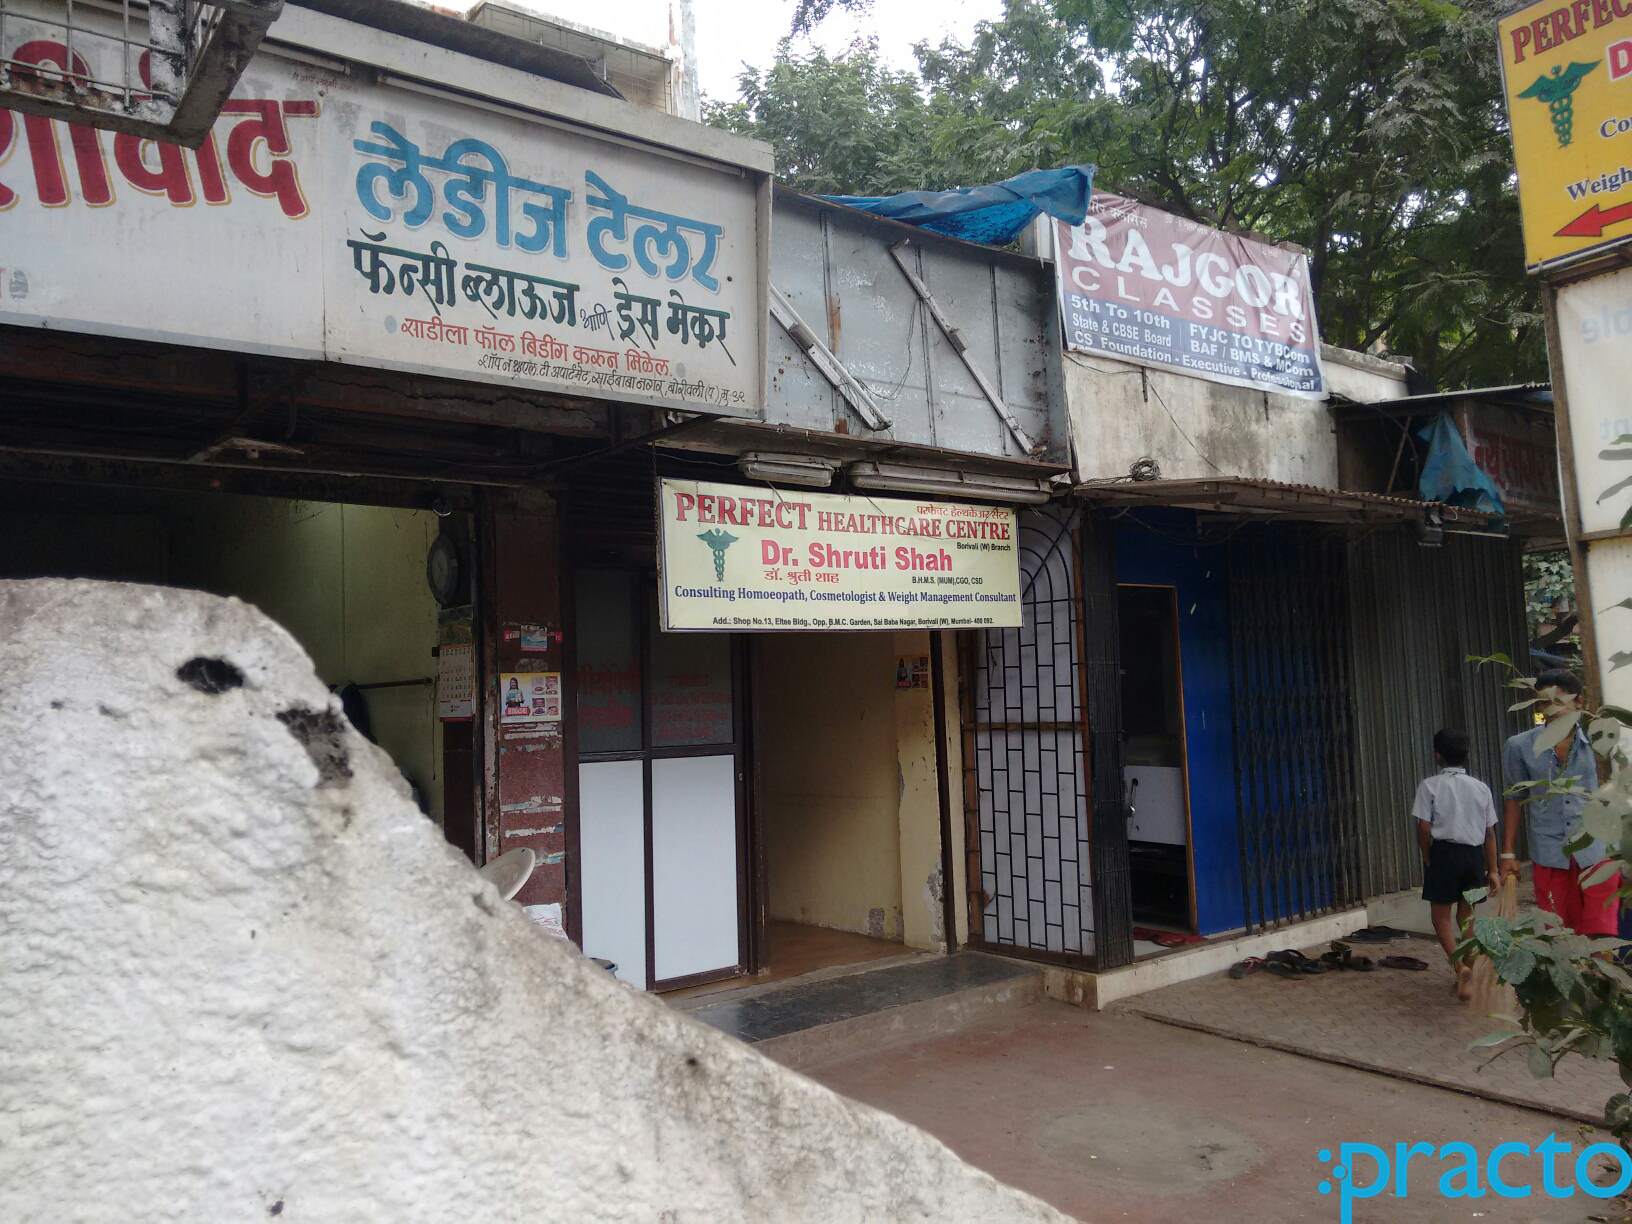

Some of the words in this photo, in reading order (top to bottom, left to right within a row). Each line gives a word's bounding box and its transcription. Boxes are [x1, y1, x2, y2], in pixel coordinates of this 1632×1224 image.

[1600, 117, 1632, 138] Co
[353, 121, 572, 260] लेडीज
[585, 169, 723, 293] टेलर
[1068, 216, 1305, 320] RAJGOR
[464, 262, 579, 328] ब्लाऊज
[666, 289, 736, 366] मेकर
[1071, 266, 1306, 343] CLASSES
[1071, 294, 1100, 313] 5th
[1105, 303, 1128, 319] To
[1134, 309, 1170, 329] 10th
[401, 316, 469, 346] साडीला
[1072, 312, 1099, 332] State
[1101, 319, 1110, 333] &
[1112, 322, 1140, 340] CBSE
[1144, 329, 1172, 347] Board
[1074, 330, 1093, 346] CS
[1100, 337, 1172, 363] Foundation
[1182, 354, 1240, 376] Executive
[1190, 340, 1218, 356] BAF
[1230, 347, 1260, 365] BMS
[1264, 355, 1273, 368] &
[1276, 358, 1314, 377] MCom
[1232, 333, 1253, 349] TO
[1255, 339, 1310, 364] TYBCom
[675, 492, 812, 531] PERFECT
[818, 509, 942, 538] HEALTHCARE
[946, 519, 1011, 541] CENTRE
[761, 539, 798, 567] Dr.
[808, 542, 887, 570] Shruti
[895, 546, 953, 572] Shah
[957, 542, 979, 550] Borivali
[980, 542, 990, 552] (W)
[991, 543, 1011, 551] Branch
[764, 568, 783, 581] डॉ.
[787, 570, 811, 585] श्रुती
[815, 571, 840, 584] शाह
[912, 576, 936, 584] B.H.M.S.
[971, 577, 983, 585] CSD
[675, 585, 735, 601] Consulting
[738, 587, 807, 603] Homoeopath,
[810, 590, 878, 604] Cosmetologist
[878, 591, 886, 602] &
[887, 591, 918, 604] Weight
[920, 592, 974, 604] Management
[974, 592, 1016, 602] Consultant
[733, 617, 751, 626] Shop
[752, 617, 773, 626] No.13,
[812, 619, 828, 627] Opp.
[829, 619, 848, 627] B.M.C.
[850, 618, 872, 627] Garden,
[884, 618, 898, 626] Baba
